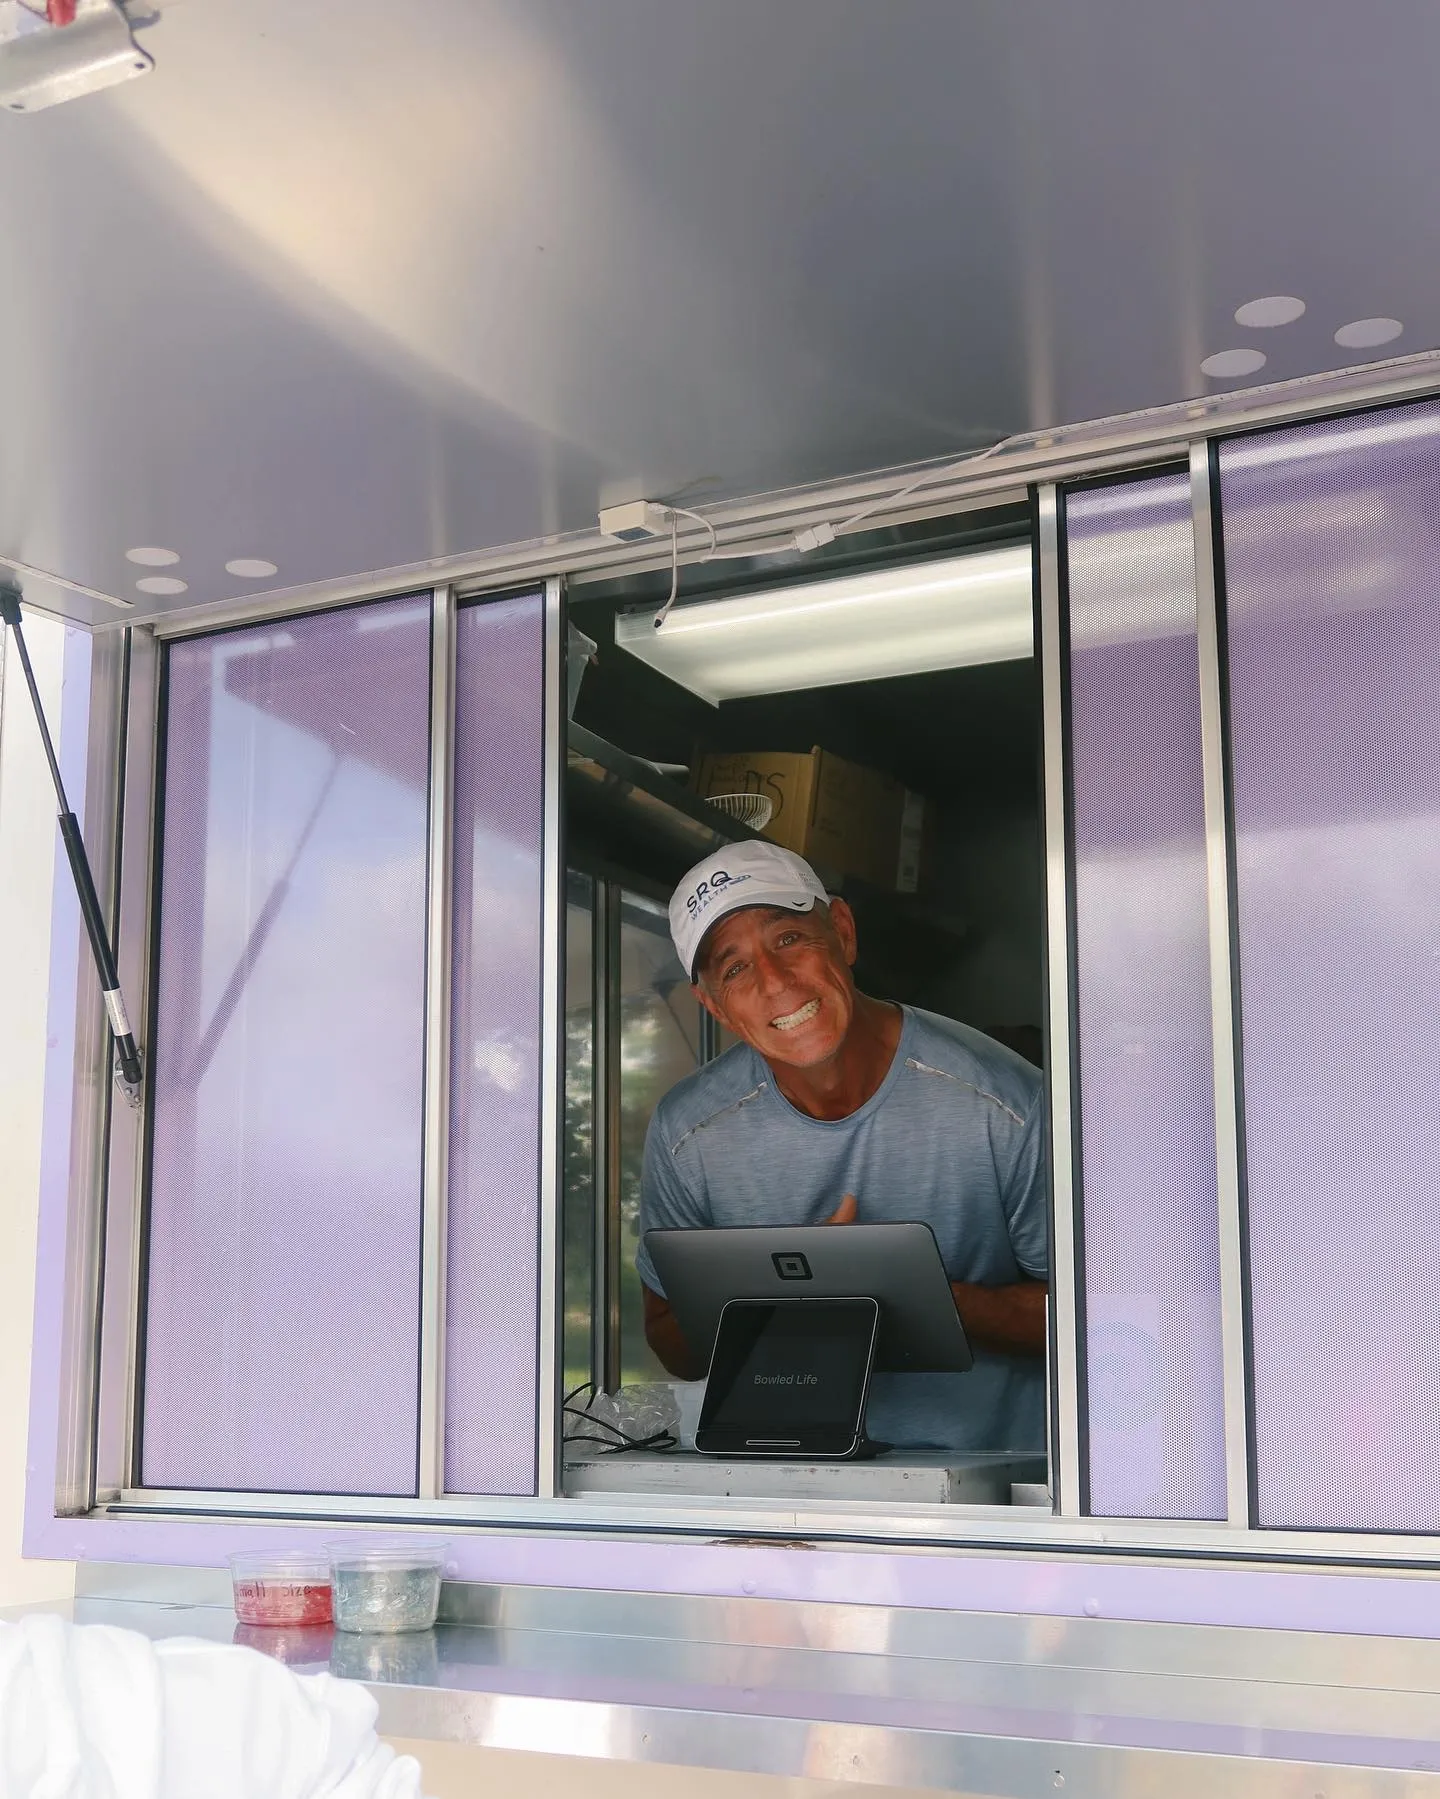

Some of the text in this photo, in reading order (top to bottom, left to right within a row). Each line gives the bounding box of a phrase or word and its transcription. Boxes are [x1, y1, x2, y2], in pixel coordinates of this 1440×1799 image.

[686, 870, 732, 914] SRQ
[690, 884, 728, 921] WEALTH
[753, 1374, 818, 1385] Bowled Life
[236, 1580, 266, 1598] mall
